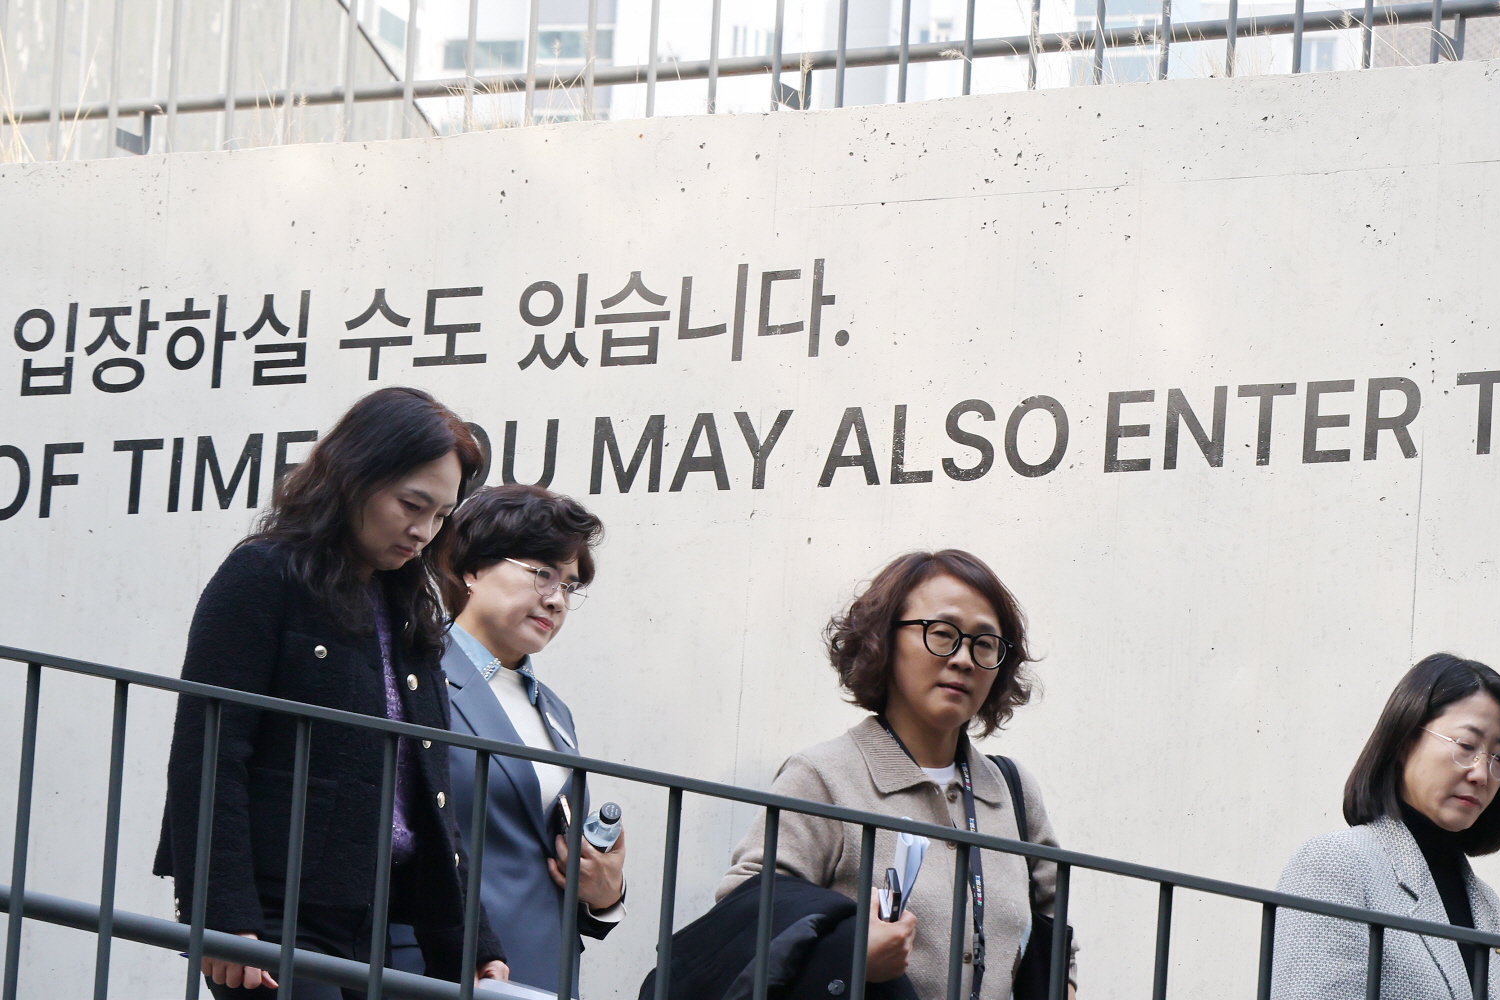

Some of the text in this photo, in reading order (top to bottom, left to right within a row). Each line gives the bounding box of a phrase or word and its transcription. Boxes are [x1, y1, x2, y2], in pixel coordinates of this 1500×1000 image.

[14, 258, 850, 396] 입장하실 수도 있습니다.
[589, 410, 793, 494] MAY
[817, 394, 1070, 488] ALSO
[1104, 377, 1420, 473] ENTER
